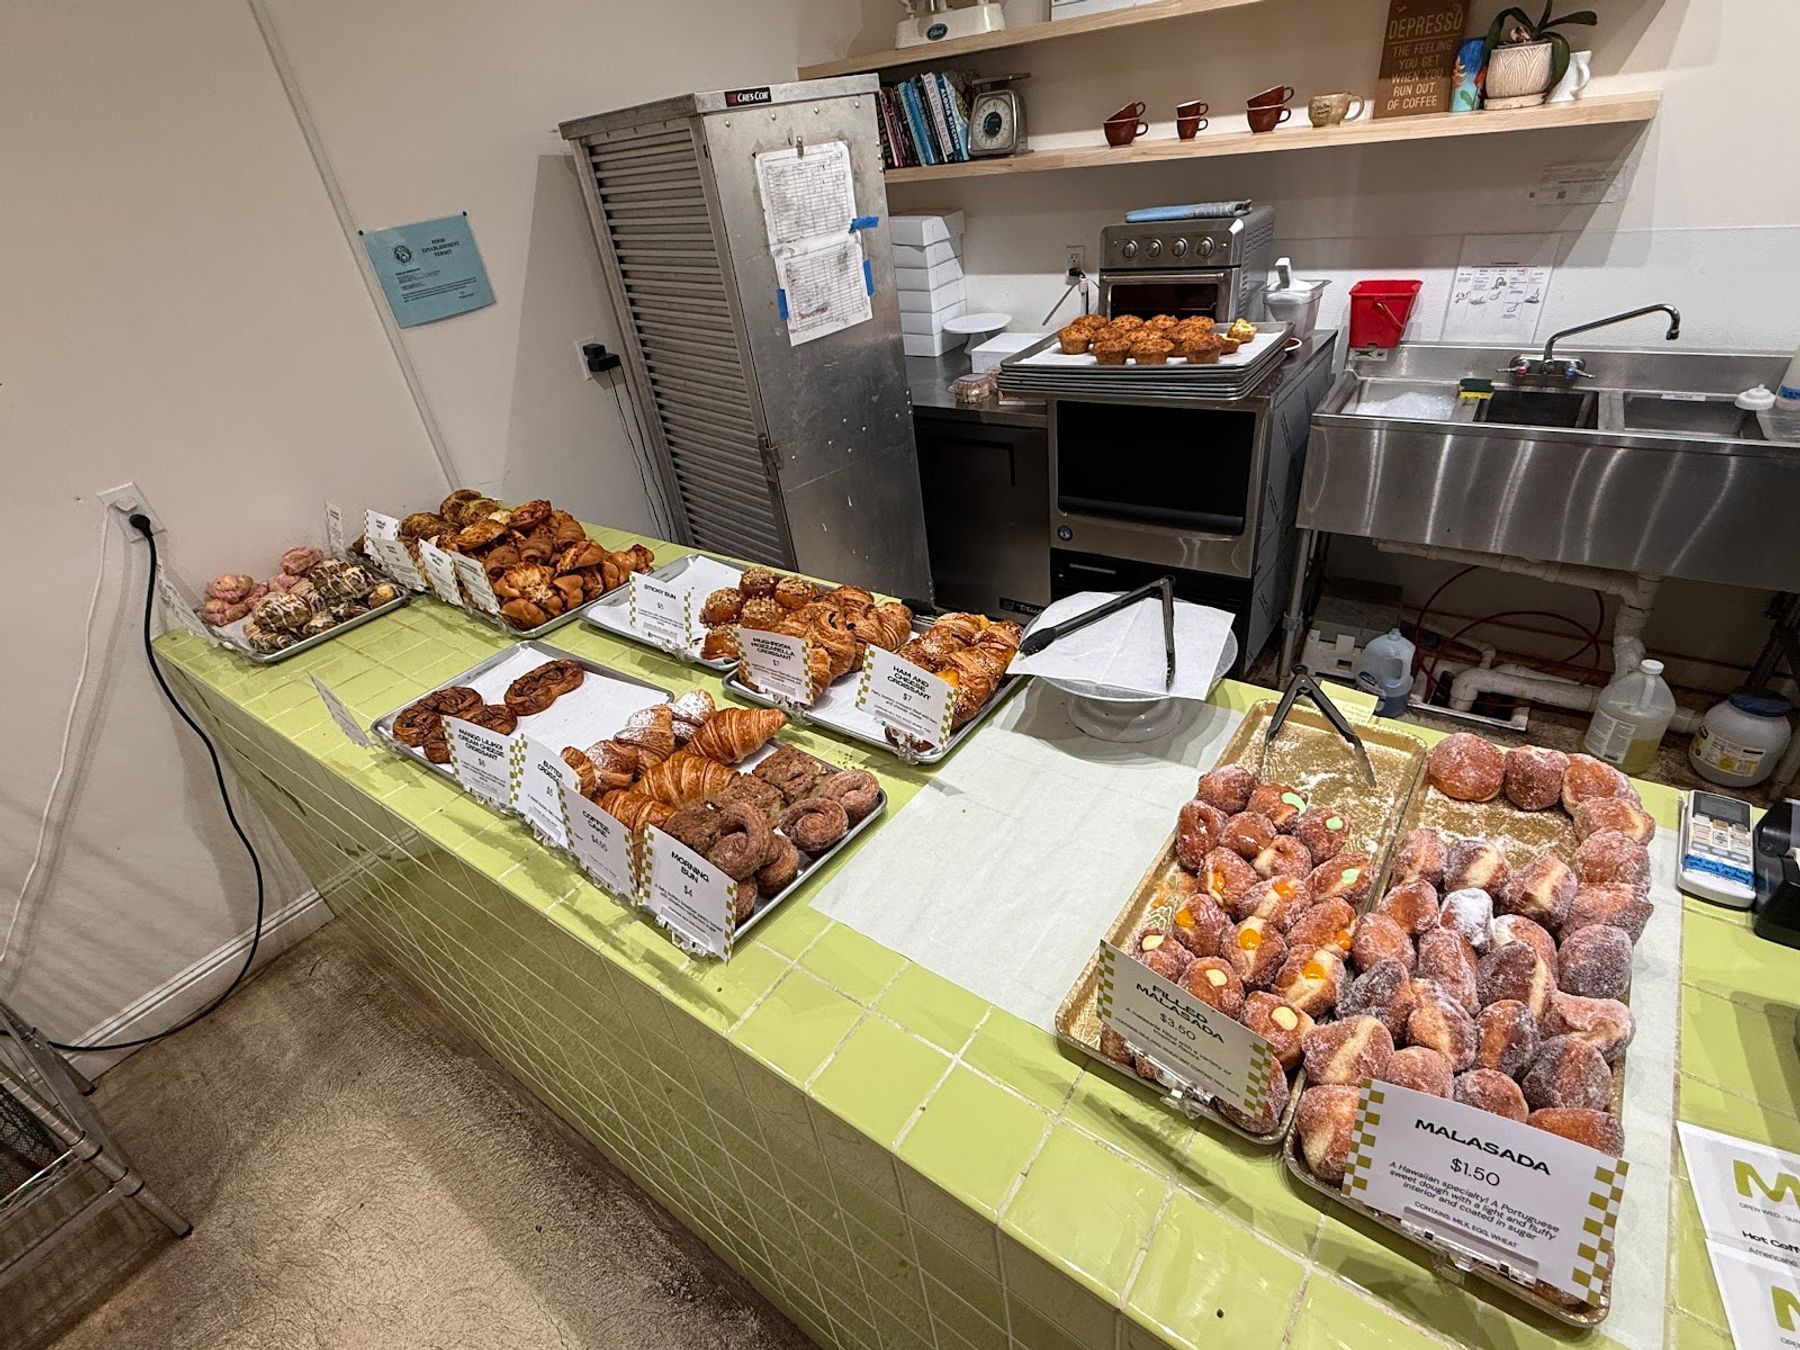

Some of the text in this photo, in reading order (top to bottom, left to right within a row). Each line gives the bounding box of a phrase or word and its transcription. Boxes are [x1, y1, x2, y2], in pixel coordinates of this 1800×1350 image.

[1389, 10, 1463, 39] DEPRESSO
[1393, 40, 1453, 57] THE FEELING
[1399, 55, 1440, 69] YOU GET
[1392, 69, 1444, 84] WHEN YOU
[1393, 82, 1436, 97] RUN OUT
[940, 88, 950, 116] ALOHA
[1387, 95, 1438, 111] OF COFFEE
[887, 675, 931, 700] CROISSANT
[893, 665, 930, 688] HAM AND
[894, 672, 926, 693] CHEESE
[902, 693, 913, 702] $7
[543, 760, 563, 780] BUTTER
[582, 810, 610, 834] COFFEE
[587, 820, 608, 838] CAKE
[671, 851, 709, 883] MORNING
[680, 866, 699, 884] BUN
[683, 885, 693, 897] $4
[1136, 983, 1224, 1043] MALASADA
[1152, 985, 1207, 1024] FILLED
[1159, 1012, 1195, 1040] $3.50
[1415, 1119, 1551, 1176] MALASADA
[1450, 1158, 1500, 1187] $1.50
[1389, 1169, 1416, 1183] sweet
[1418, 1180, 1448, 1197] dough
[1451, 1192, 1471, 1204] with
[1482, 1205, 1504, 1219] light
[1506, 1215, 1526, 1227] and
[1528, 1224, 1556, 1241] fluffy
[1398, 1164, 1440, 1184] Hawaiian
[1441, 1181, 1488, 1204] specialty!
[1490, 1199, 1498, 1207] A
[1500, 1203, 1559, 1233] Portuguese
[1739, 1202, 1761, 1213] OPEN
[1402, 1181, 1536, 1241] interior and coated in sugar
[1490, 1233, 1516, 1247] WHEAT
[1742, 1230, 1769, 1245] Hot
[1749, 1246, 1798, 1268] Americano
